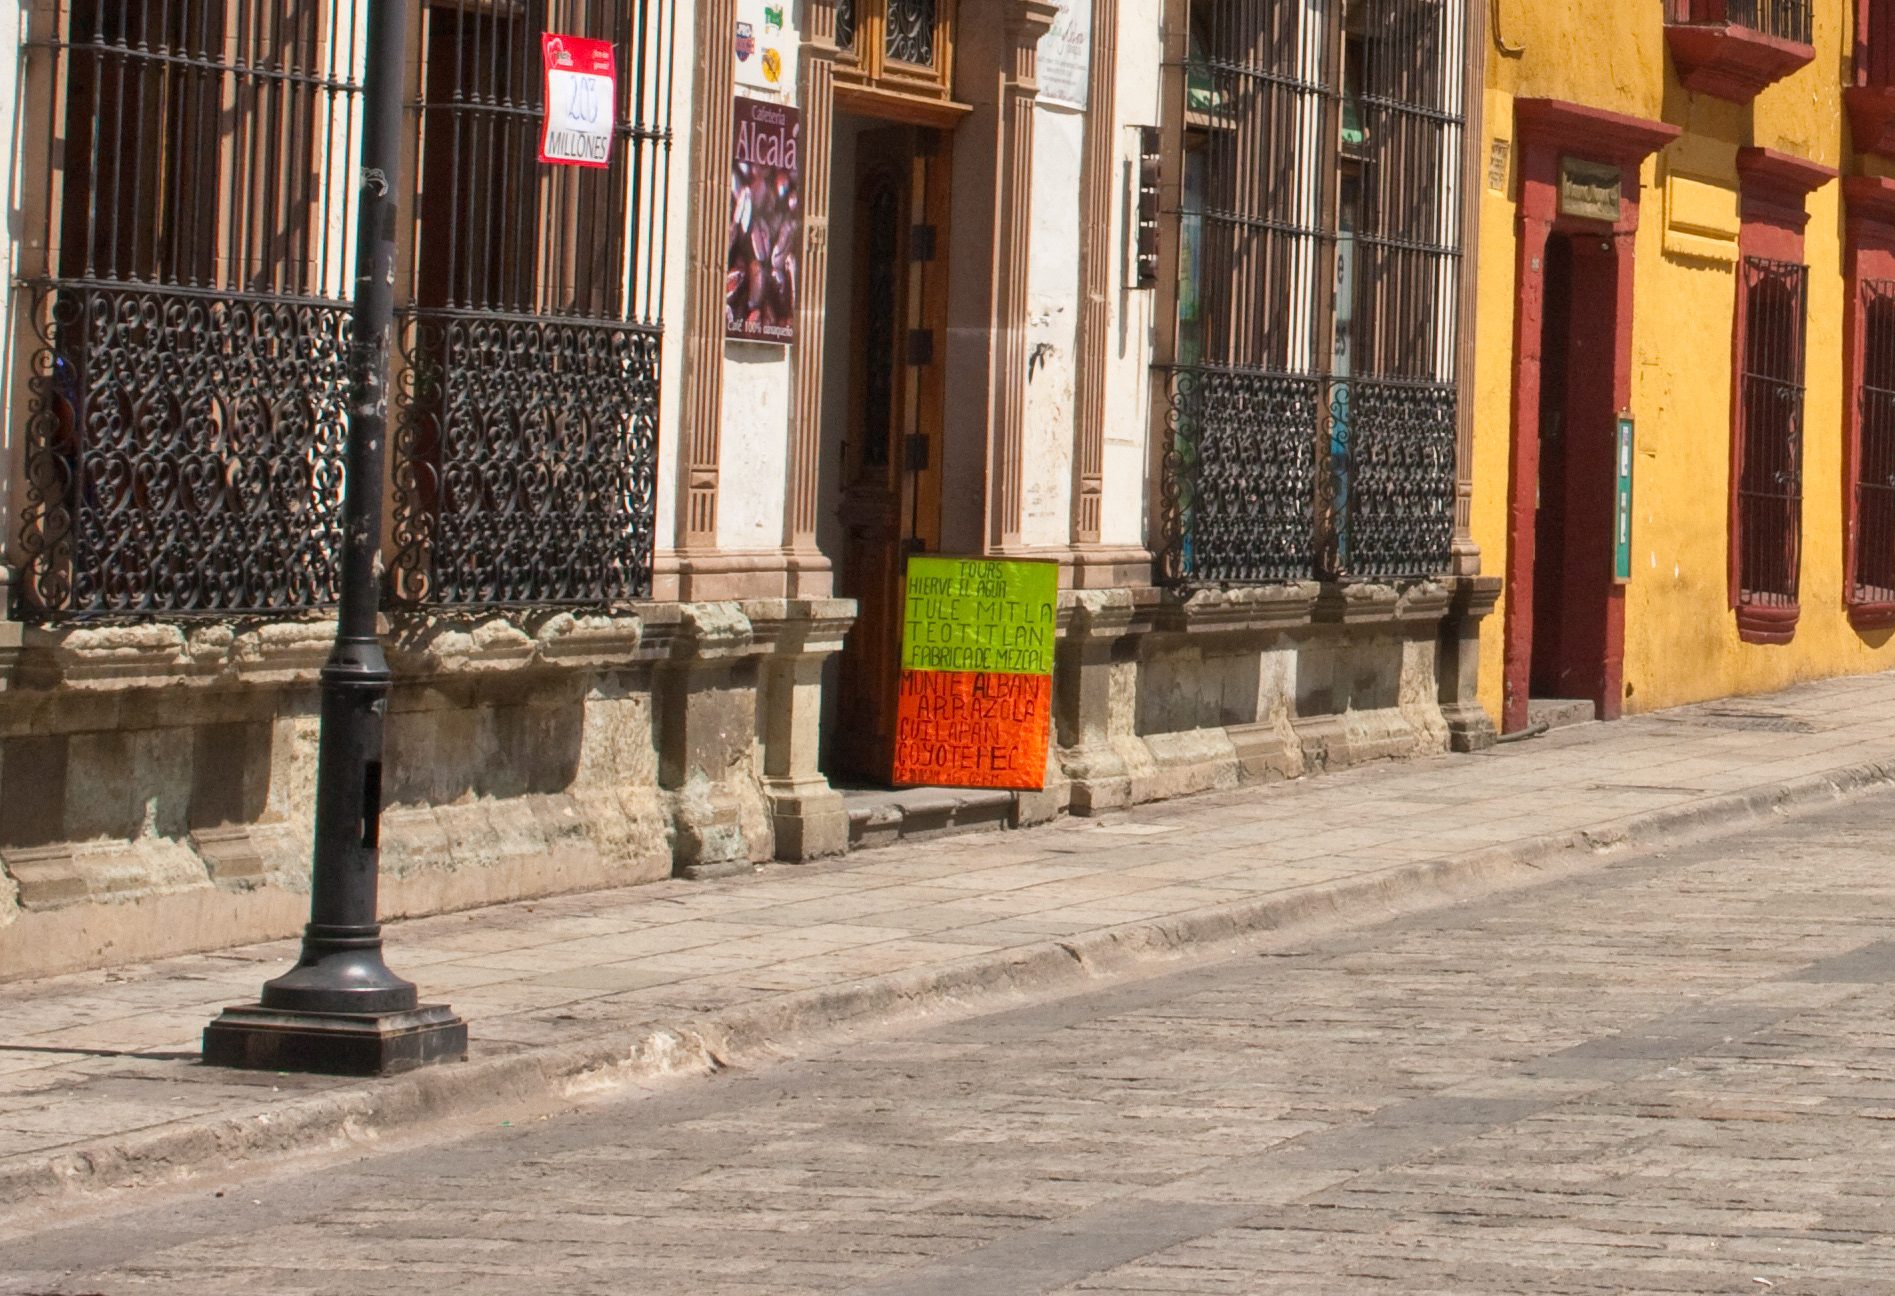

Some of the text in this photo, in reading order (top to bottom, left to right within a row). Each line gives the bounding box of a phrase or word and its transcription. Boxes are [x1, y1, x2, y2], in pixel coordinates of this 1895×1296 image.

[547, 131, 608, 160] MILLONES
[735, 120, 800, 171] Alcalá
[959, 561, 1003, 579] TOURS
[908, 577, 1008, 599] HIERVE EL AGUA
[908, 597, 1053, 624] TULE MITLA
[906, 621, 1043, 647] TEOTITLAN
[996, 649, 1047, 672] MEZCAL
[900, 671, 1040, 700] MONTE ALBAN
[916, 695, 1036, 723] ARRAZOLA
[899, 716, 999, 745] CUILAPAN
